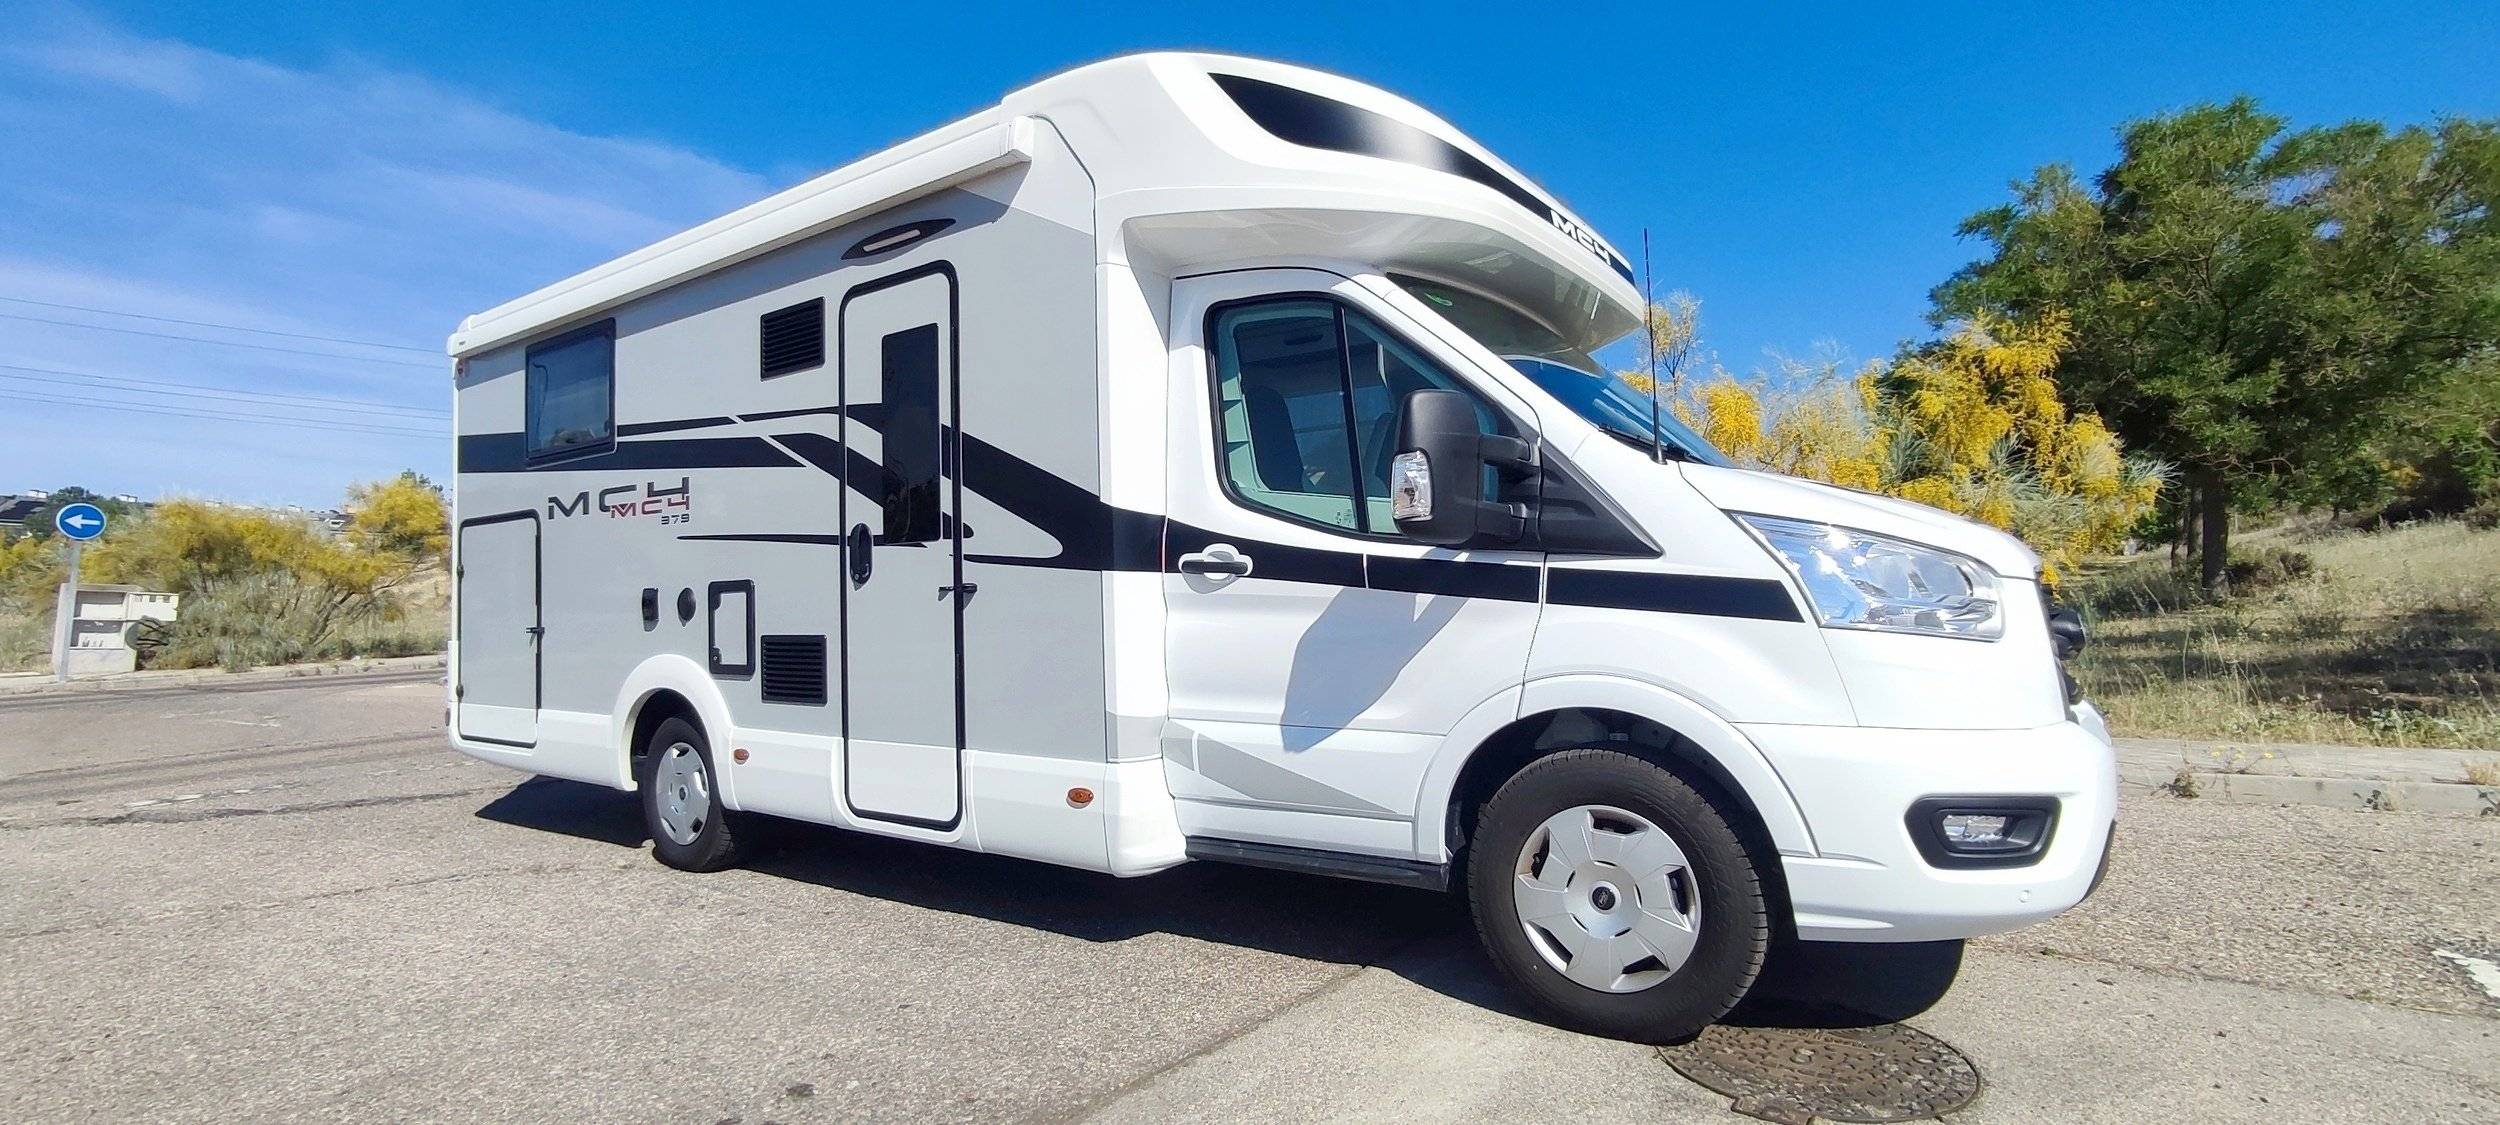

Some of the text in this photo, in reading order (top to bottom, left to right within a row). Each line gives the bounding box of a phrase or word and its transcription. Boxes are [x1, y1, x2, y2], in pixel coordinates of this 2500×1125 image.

[1550, 209, 1611, 266] MC4
[548, 477, 690, 520] MC4
[611, 495, 690, 518] MC4
[661, 513, 690, 525] 379
